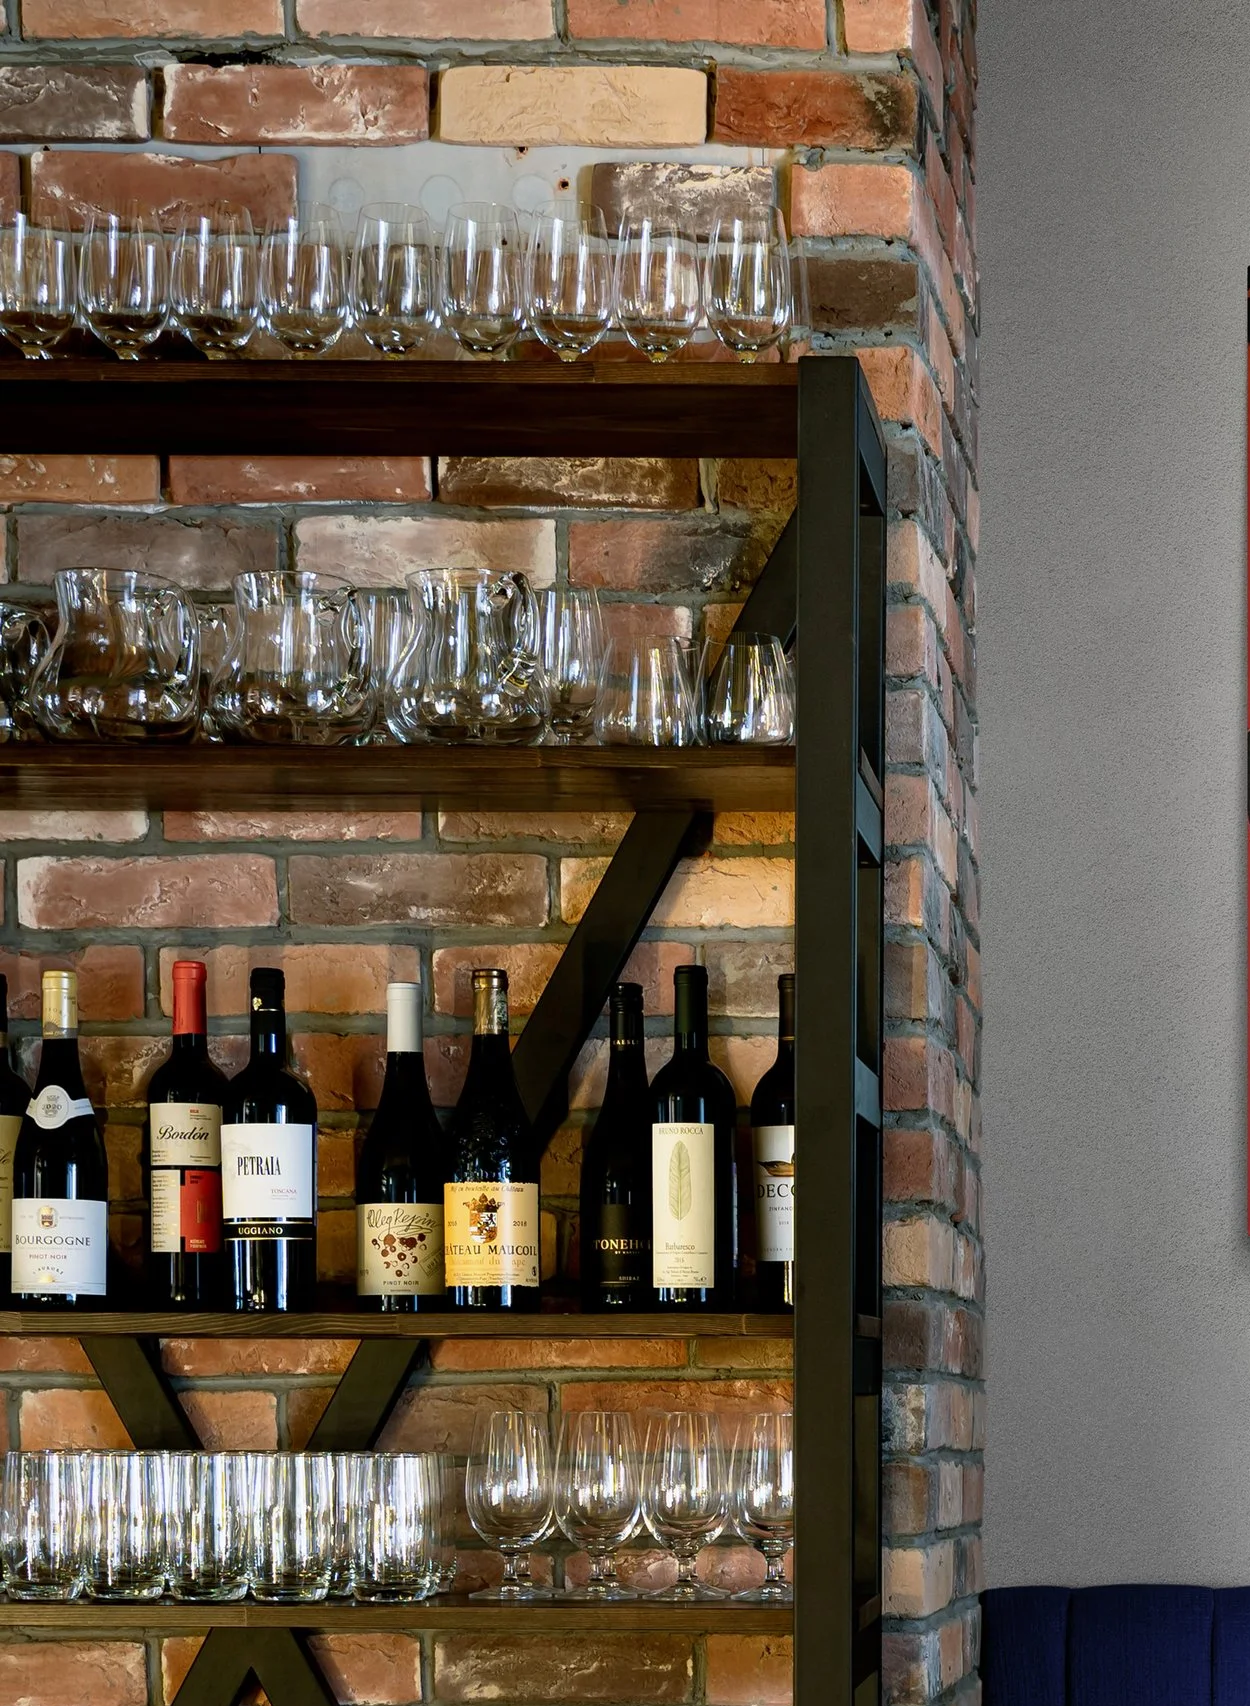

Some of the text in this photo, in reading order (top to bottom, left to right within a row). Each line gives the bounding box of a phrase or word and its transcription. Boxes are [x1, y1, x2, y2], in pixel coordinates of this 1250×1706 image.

[156, 1125, 210, 1141] Bordón
[658, 1127, 704, 1135] BRUNO ROCCA
[237, 1156, 281, 1176] PETRAIA
[757, 1183, 795, 1198] DEC
[238, 1226, 283, 1235] UGGIANO
[15, 1234, 91, 1247] BOURGOGNE
[488, 1245, 537, 1256] MAUCOIL
